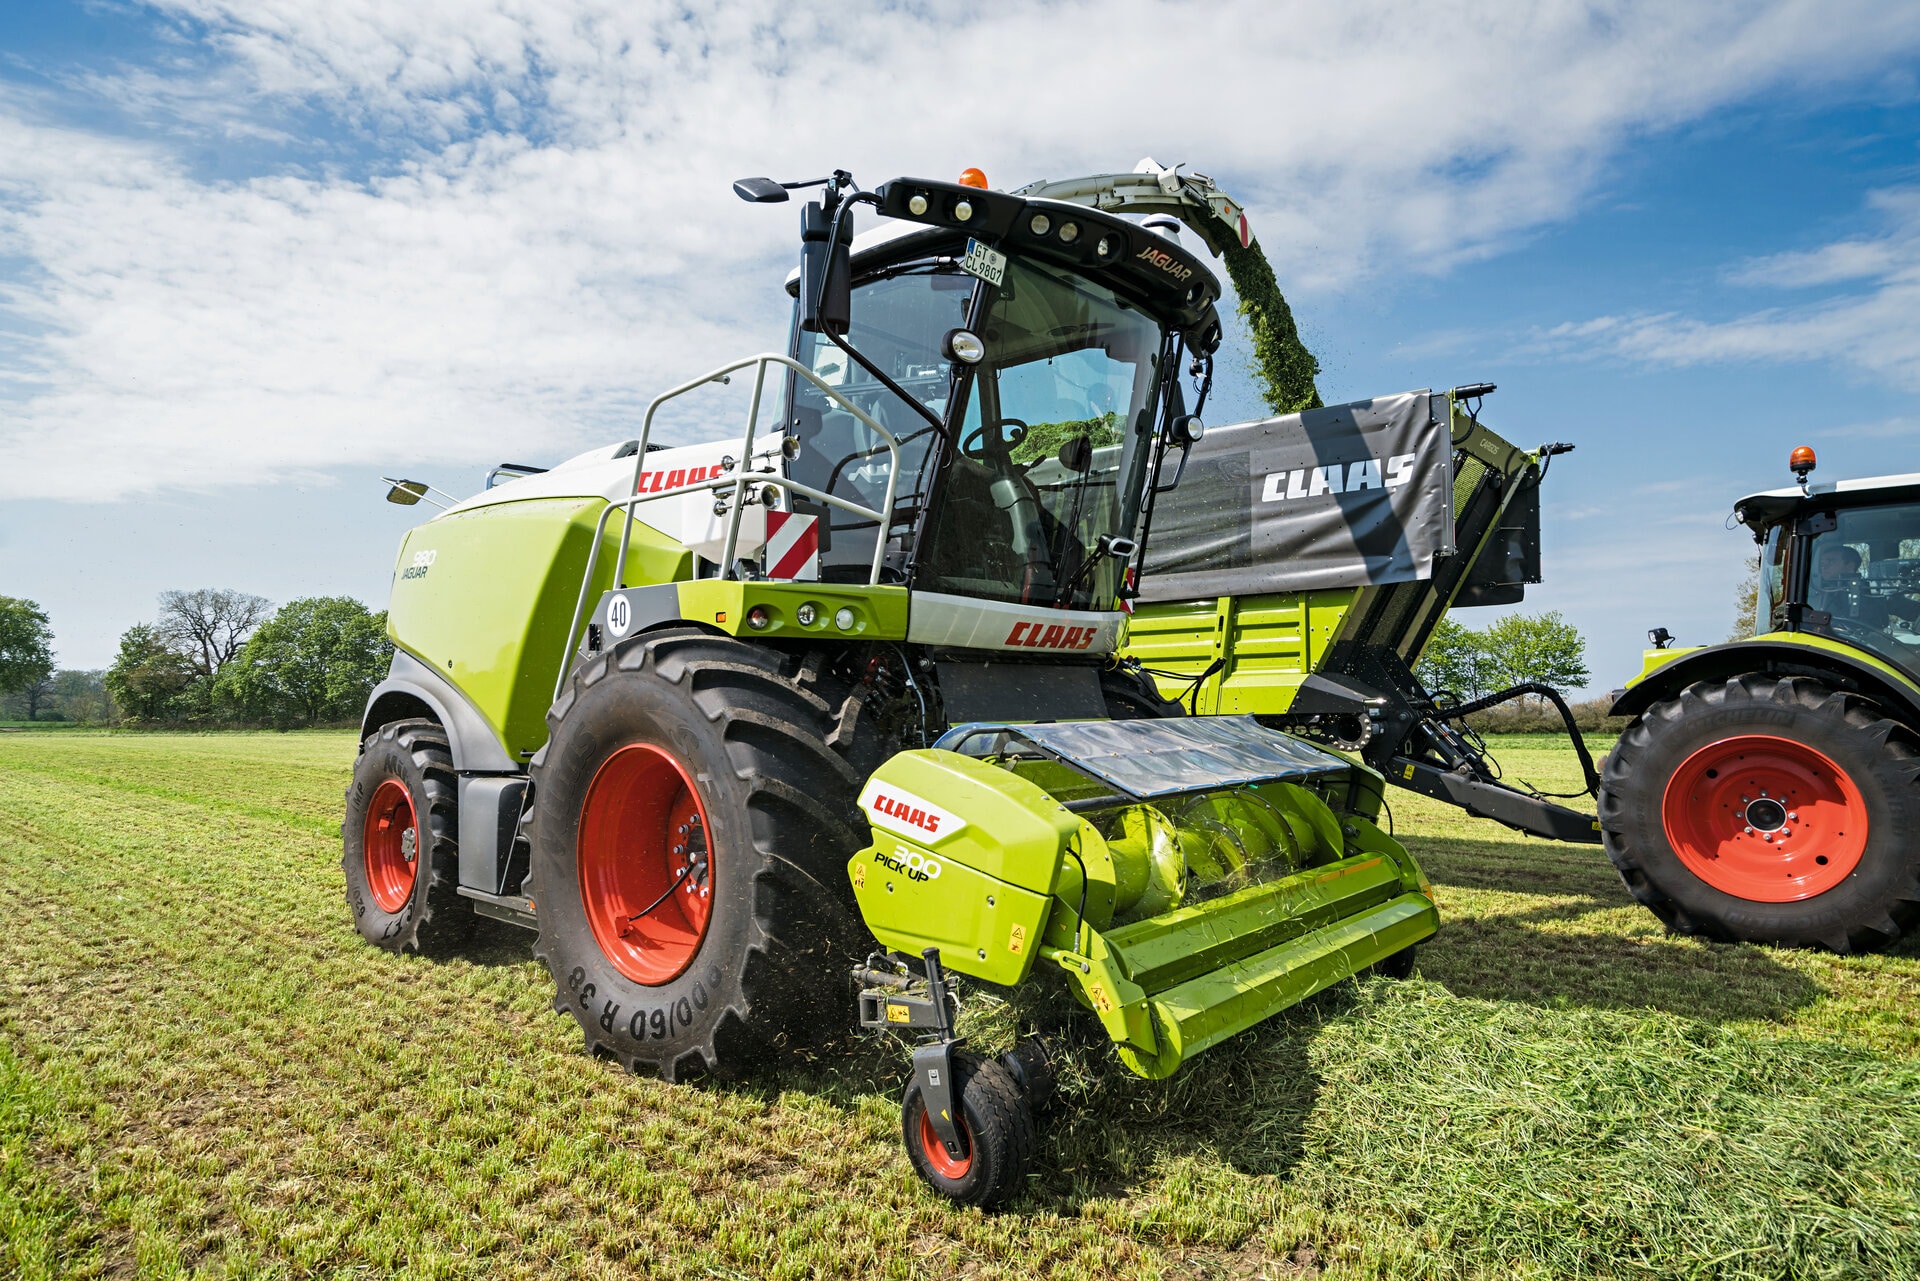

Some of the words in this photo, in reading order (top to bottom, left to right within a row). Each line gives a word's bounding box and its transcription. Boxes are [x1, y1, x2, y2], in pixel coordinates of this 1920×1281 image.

[975, 244, 988, 260] GT
[1136, 246, 1193, 282] JAGUAR
[965, 255, 977, 272] CL
[979, 262, 1003, 283] 9807
[1262, 452, 1416, 502] CLAAS
[401, 565, 428, 580] JAGUAR
[412, 549, 437, 568] 980
[611, 601, 626, 628] 40
[1005, 621, 1098, 649] CLAAS
[873, 794, 941, 832] CLAAS
[874, 852, 906, 875] PICK
[907, 867, 929, 883] UP
[891, 844, 943, 879] 300
[568, 966, 597, 1010] 38
[600, 1000, 620, 1034] R
